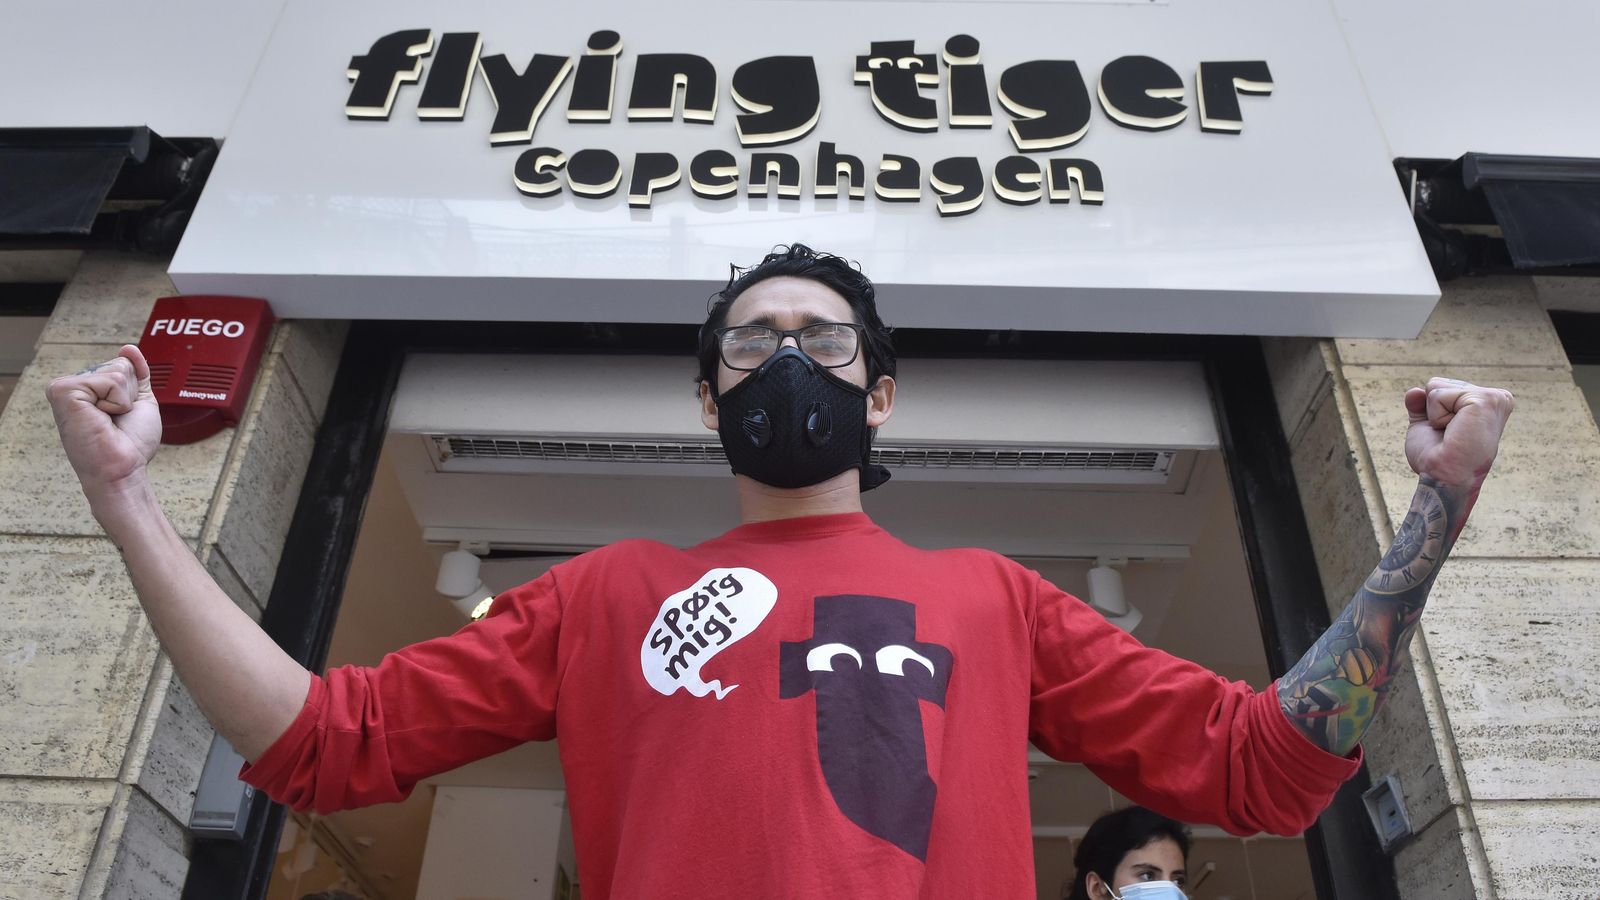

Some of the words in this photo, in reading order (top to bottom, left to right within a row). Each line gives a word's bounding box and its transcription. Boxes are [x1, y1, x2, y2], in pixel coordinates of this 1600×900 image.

[345, 28, 822, 148] flying
[853, 34, 1274, 153] tiger
[513, 141, 1105, 217] copenhagen
[150, 318, 245, 338] FUEGO
[179, 390, 227, 401] Honeywell
[664, 601, 738, 680] mig!
